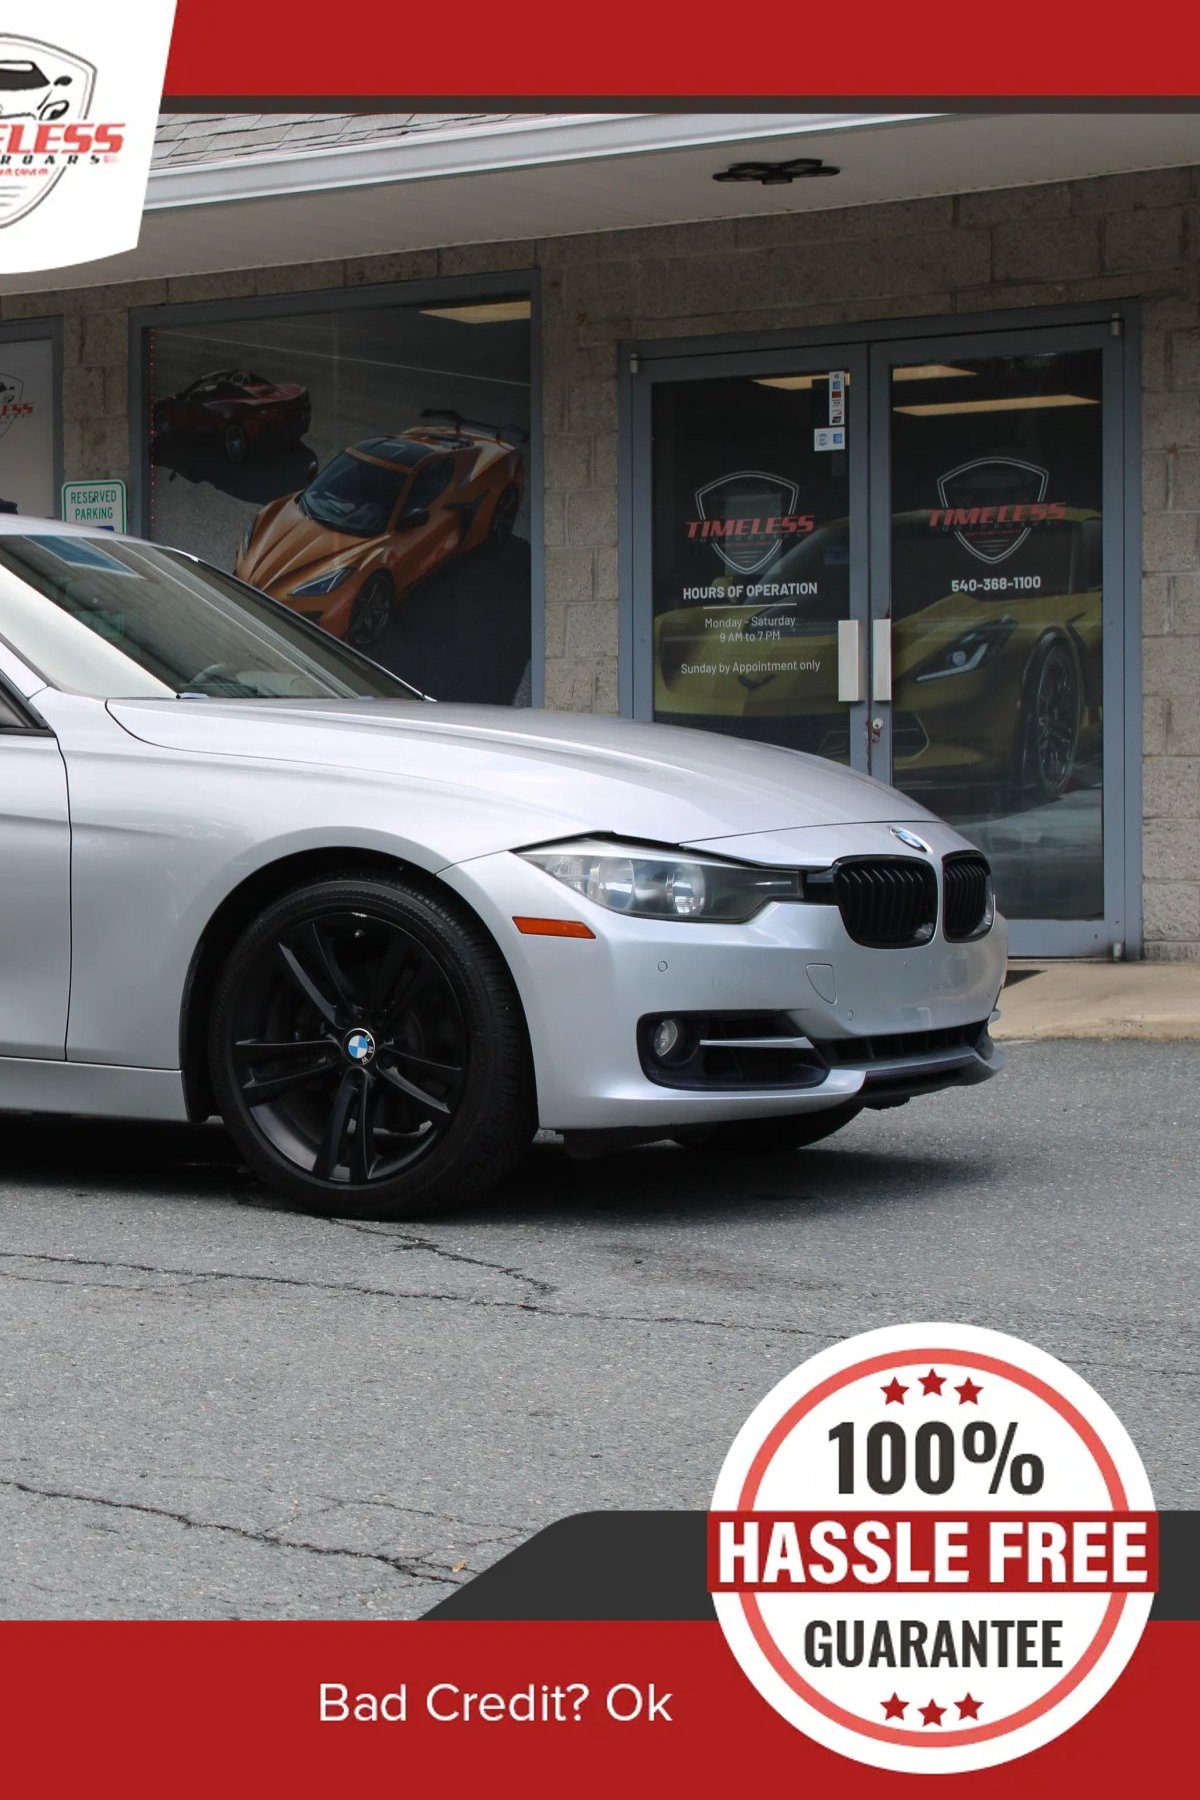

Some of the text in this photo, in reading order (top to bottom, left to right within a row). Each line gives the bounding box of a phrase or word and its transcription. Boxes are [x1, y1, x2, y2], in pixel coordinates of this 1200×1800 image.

[71, 490, 117, 504] RESERVED
[75, 507, 113, 520] PARKING
[927, 502, 1067, 527] TIMELESS
[686, 515, 815, 538] TIMELESS
[683, 582, 818, 600] HOURS OF OPERATION
[951, 576, 1042, 592] 540-368-1100
[704, 617, 743, 630] Monday
[751, 615, 796, 628] Saturday
[719, 630, 781, 643] 9 AM to 7 PM
[680, 660, 821, 676] Sunday by Appointment only
